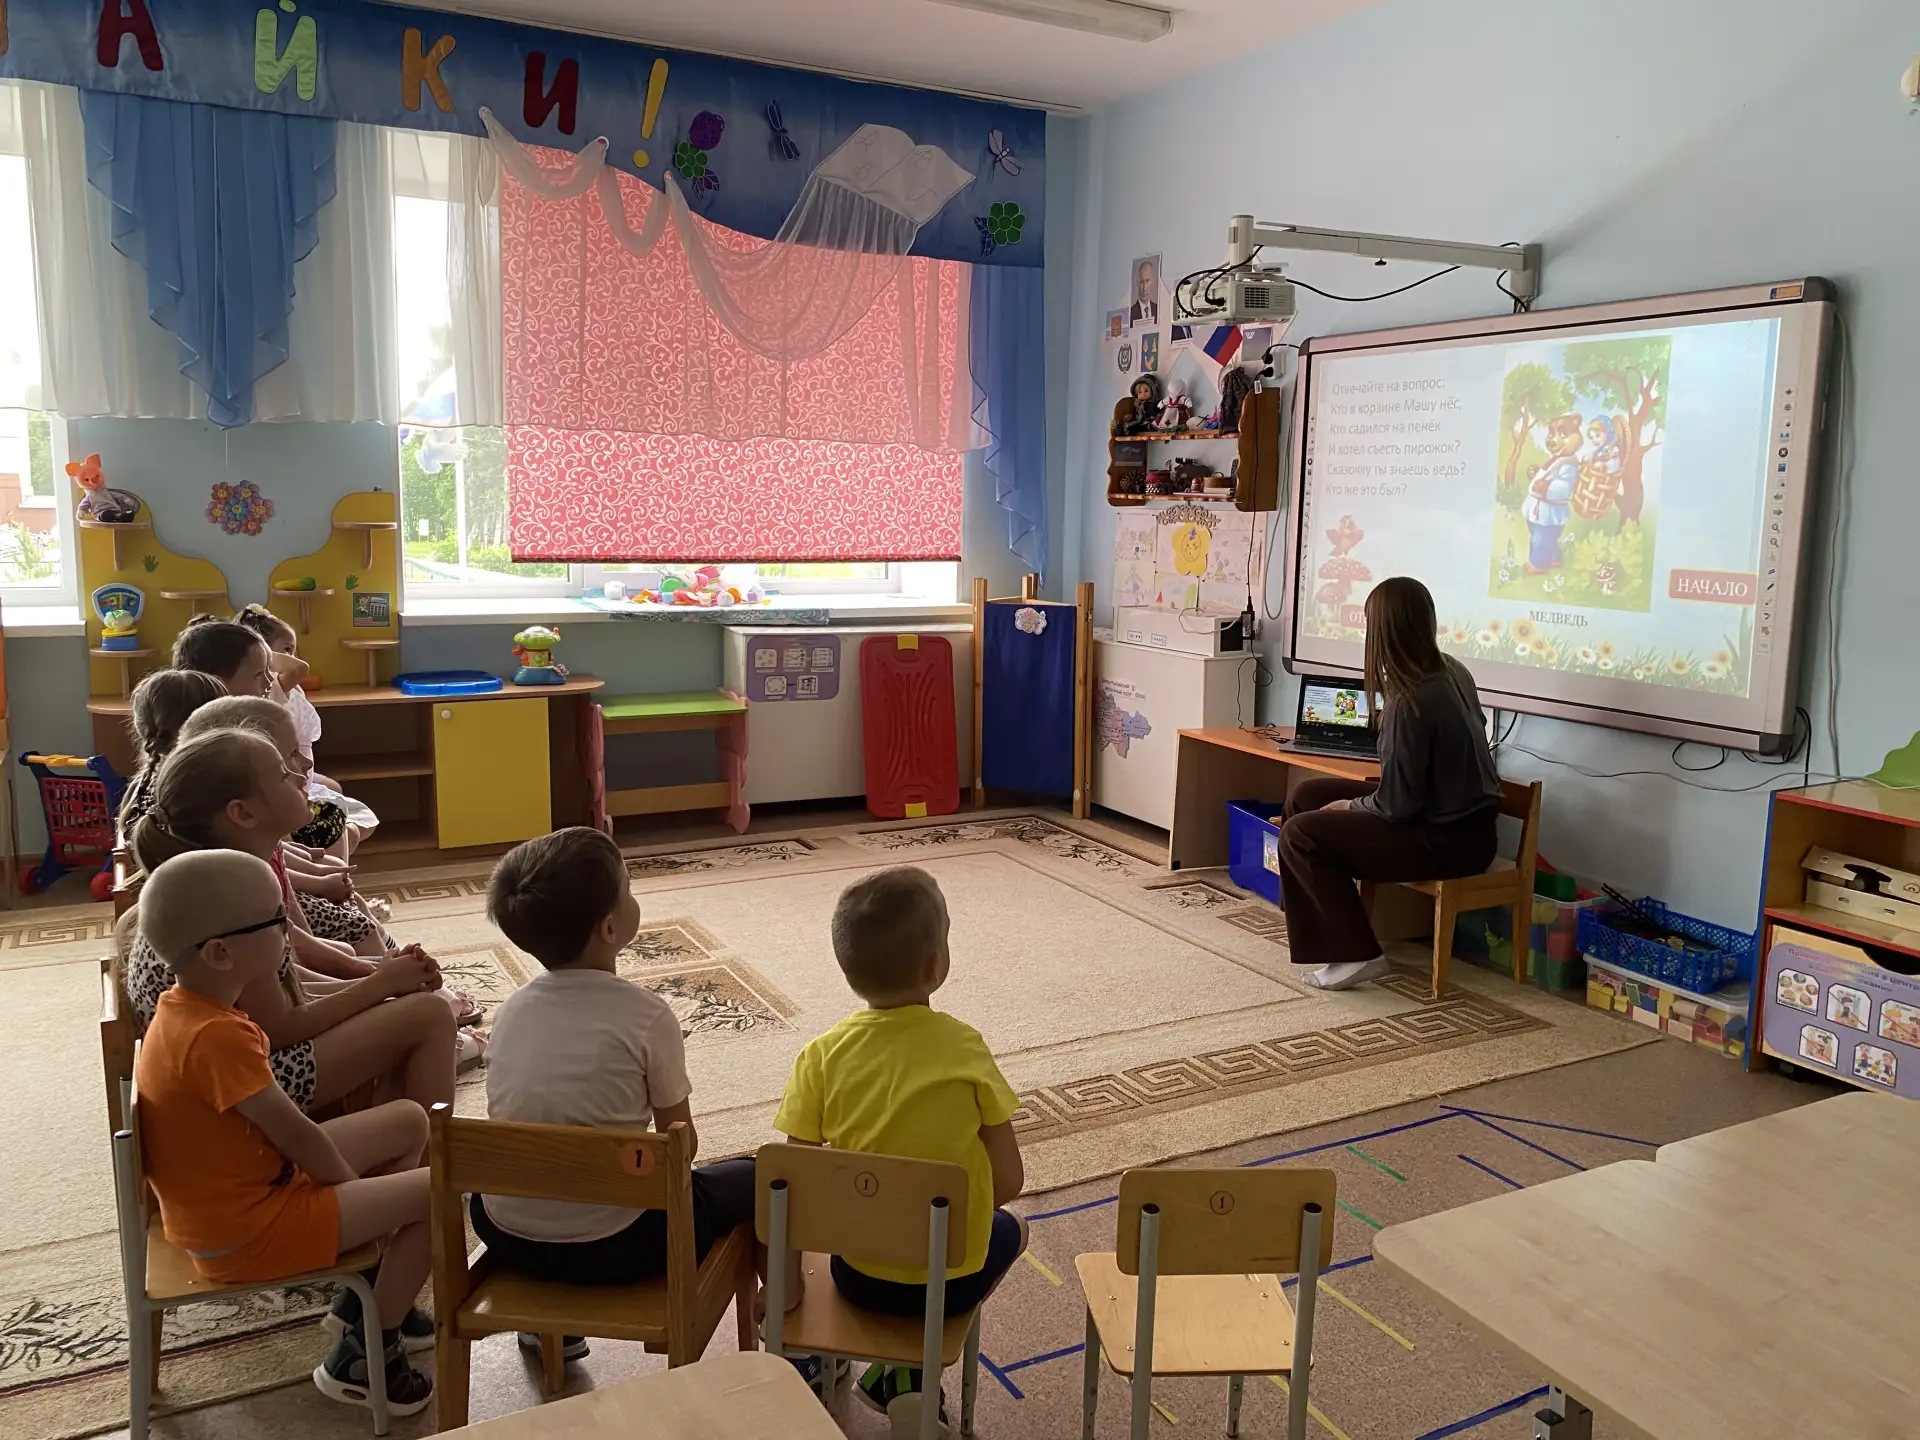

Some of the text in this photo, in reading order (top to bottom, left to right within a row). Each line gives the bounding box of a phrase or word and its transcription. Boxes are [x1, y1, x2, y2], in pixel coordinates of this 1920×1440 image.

[0, 0, 668, 168] АЙКИ!
[1332, 377, 1446, 396] Отвечайте на вопрос:
[1330, 396, 1462, 417] Кто в корзине Машу нёс,
[1329, 419, 1441, 436] Кто садился на пенёк
[1328, 439, 1461, 456] И хотел съесть пирожок?
[1326, 461, 1467, 478] Сказочку ты знаешь ведь?
[1325, 482, 1407, 496] Кто же это был?
[1676, 577, 1748, 597] НАЧАЛО
[1349, 611, 1367, 624] ОТ
[1528, 610, 1588, 628] МЕДВЕДЬ
[634, 1148, 643, 1168] 1
[863, 1178, 869, 1191] 1
[1219, 1196, 1225, 1209] 1
